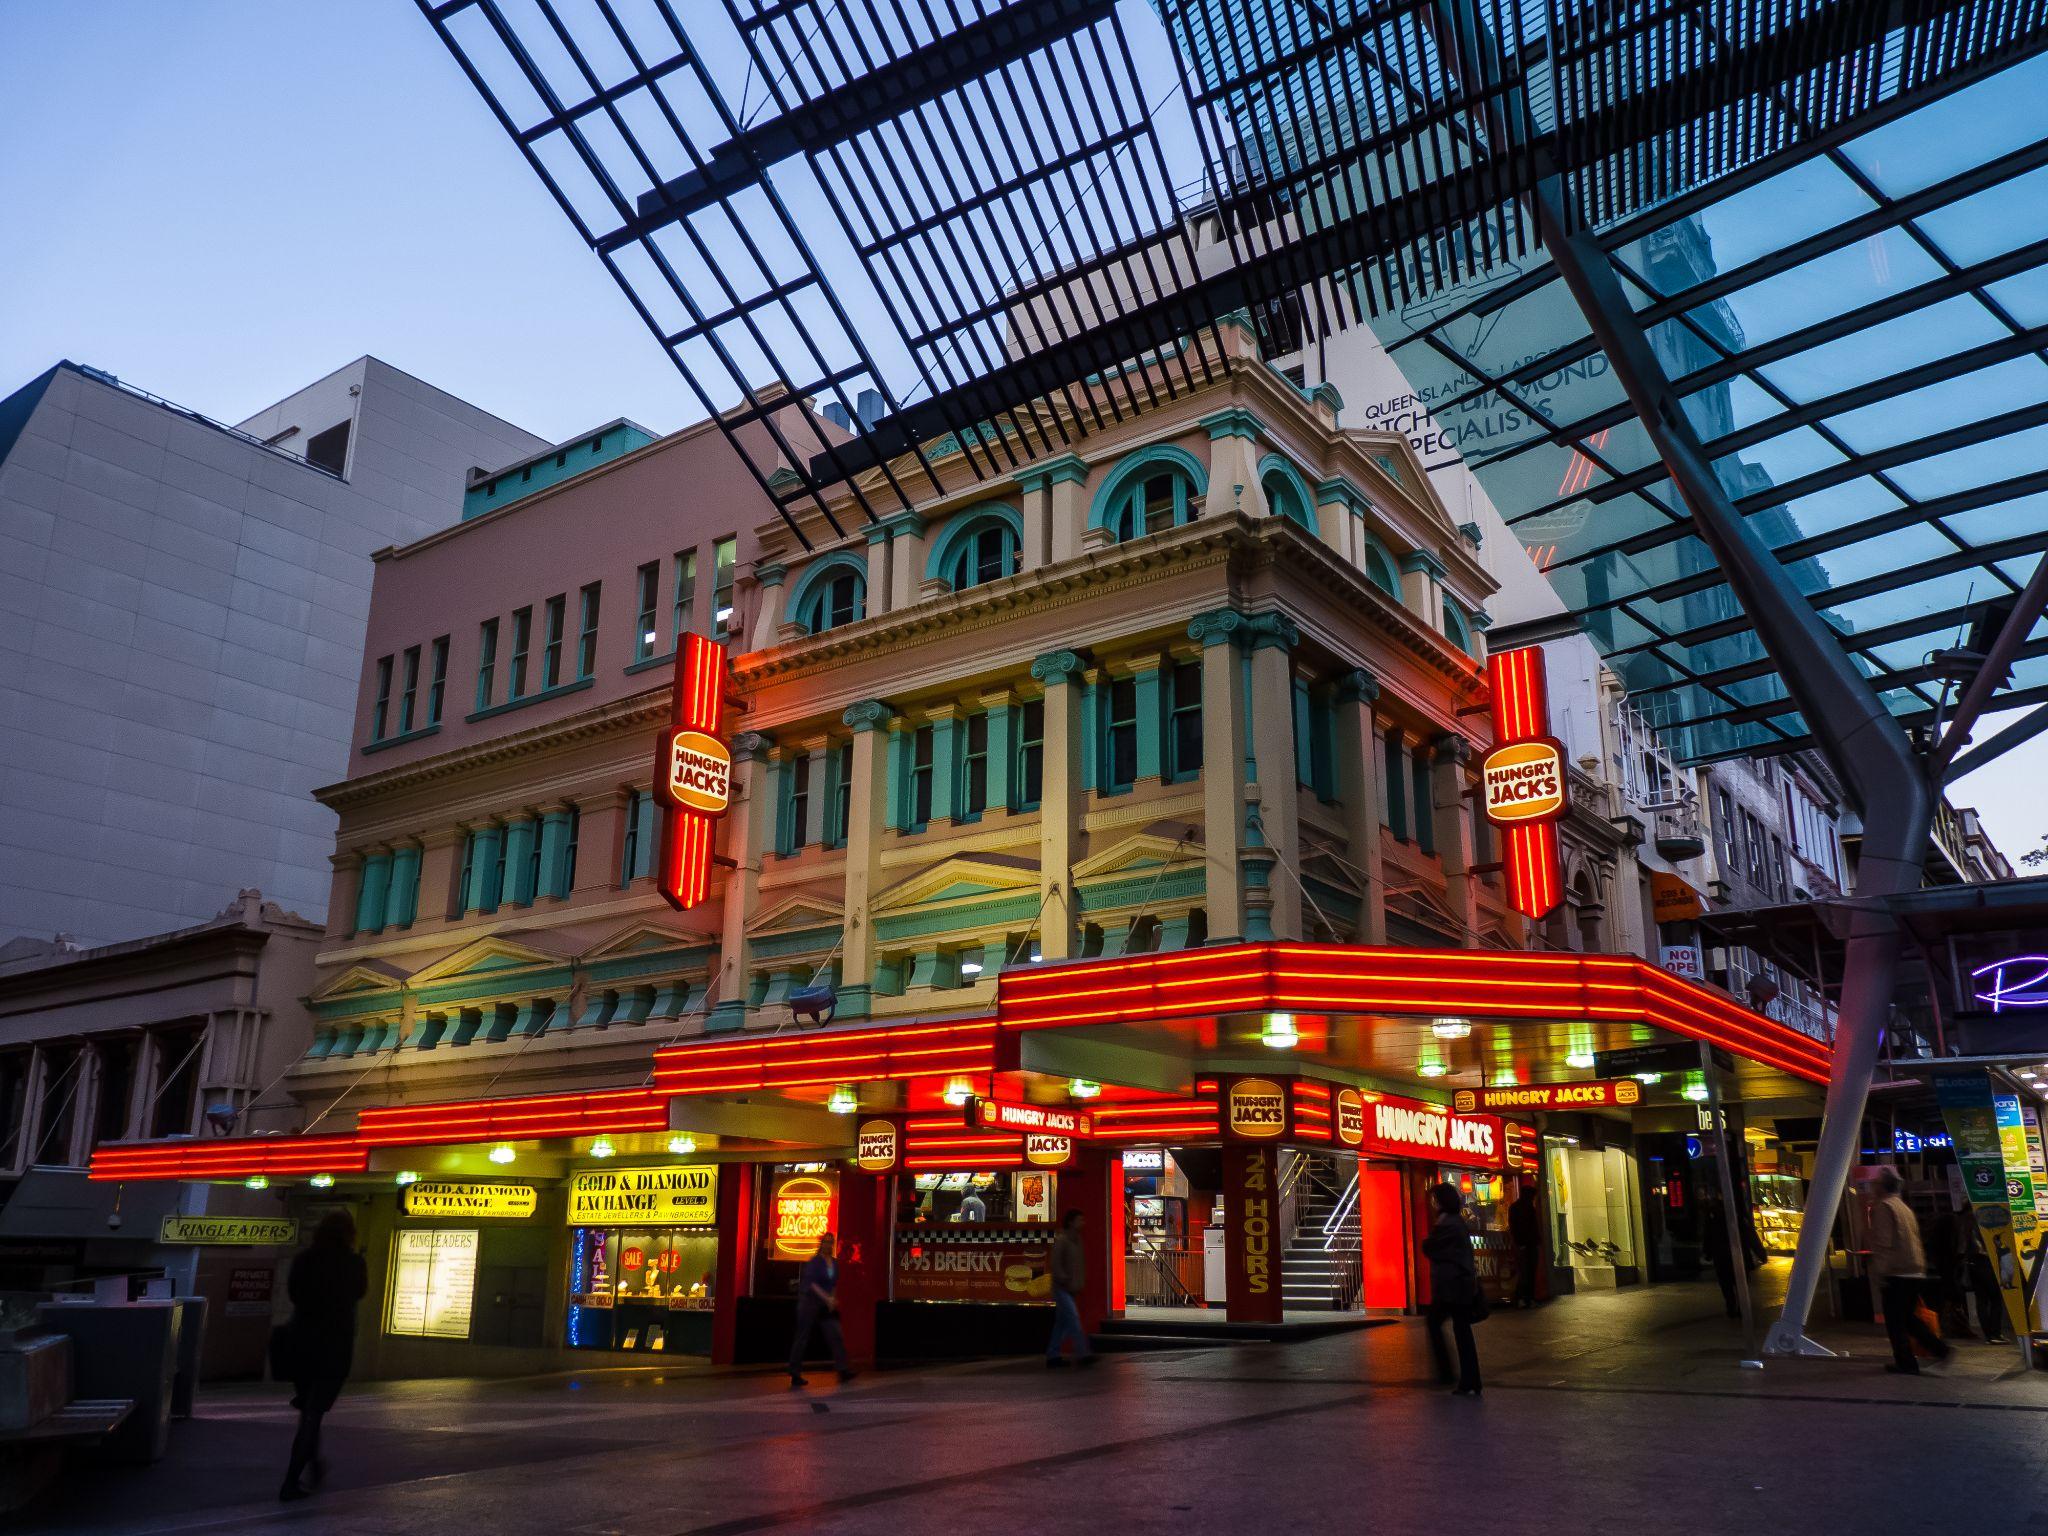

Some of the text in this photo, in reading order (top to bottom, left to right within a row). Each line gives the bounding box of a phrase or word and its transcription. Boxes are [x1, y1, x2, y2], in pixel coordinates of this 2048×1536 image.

[1366, 406, 1432, 435] TCH
[1409, 397, 1555, 456] PECIALISTS
[676, 749, 728, 776] HUNGRY
[675, 765, 727, 796] JACK'S
[1487, 761, 1555, 785] HUNGRY
[1489, 777, 1557, 804] JACK'S
[1233, 1096, 1281, 1107] HUNGRY
[1485, 1086, 1605, 1106] HUNGRY JACK'S
[1002, 1106, 1046, 1126] HUNGRY
[1234, 1108, 1282, 1122] JACK'S
[1376, 1103, 1447, 1147] HUNGRY
[1449, 1118, 1494, 1156] JACK'S
[860, 1135, 893, 1145] HUNGRY
[1029, 1138, 1069, 1153] JACK'S
[860, 1145, 893, 1158] JACK'S
[577, 1172, 709, 1192] GOLD & DIAMOND
[413, 1183, 531, 1197] GOLD & DIAMOND
[413, 1196, 493, 1208] EXCHANGE
[577, 1194, 706, 1211] EXCHANGE LEVEL 3
[778, 1199, 830, 1215] HUNGRY
[411, 1207, 437, 1215] ESTATE
[577, 1210, 709, 1220] ESTATE JEWELLERS & PAWNBROKERS
[178, 1223, 289, 1238] RINGLEADERS
[776, 1215, 829, 1236] JACK'S
[1243, 1154, 1270, 1294] 24 HOURS
[409, 1234, 473, 1248] RINGLEADERS
[624, 1251, 642, 1266] SALE
[660, 1253, 678, 1268] SAE
[934, 1250, 1004, 1272] BREKKY
[234, 1270, 270, 1279] PRIVATE
[231, 1281, 271, 1289] PARKING
[238, 1291, 260, 1299] ONLY
[596, 1295, 612, 1307] GOLD
